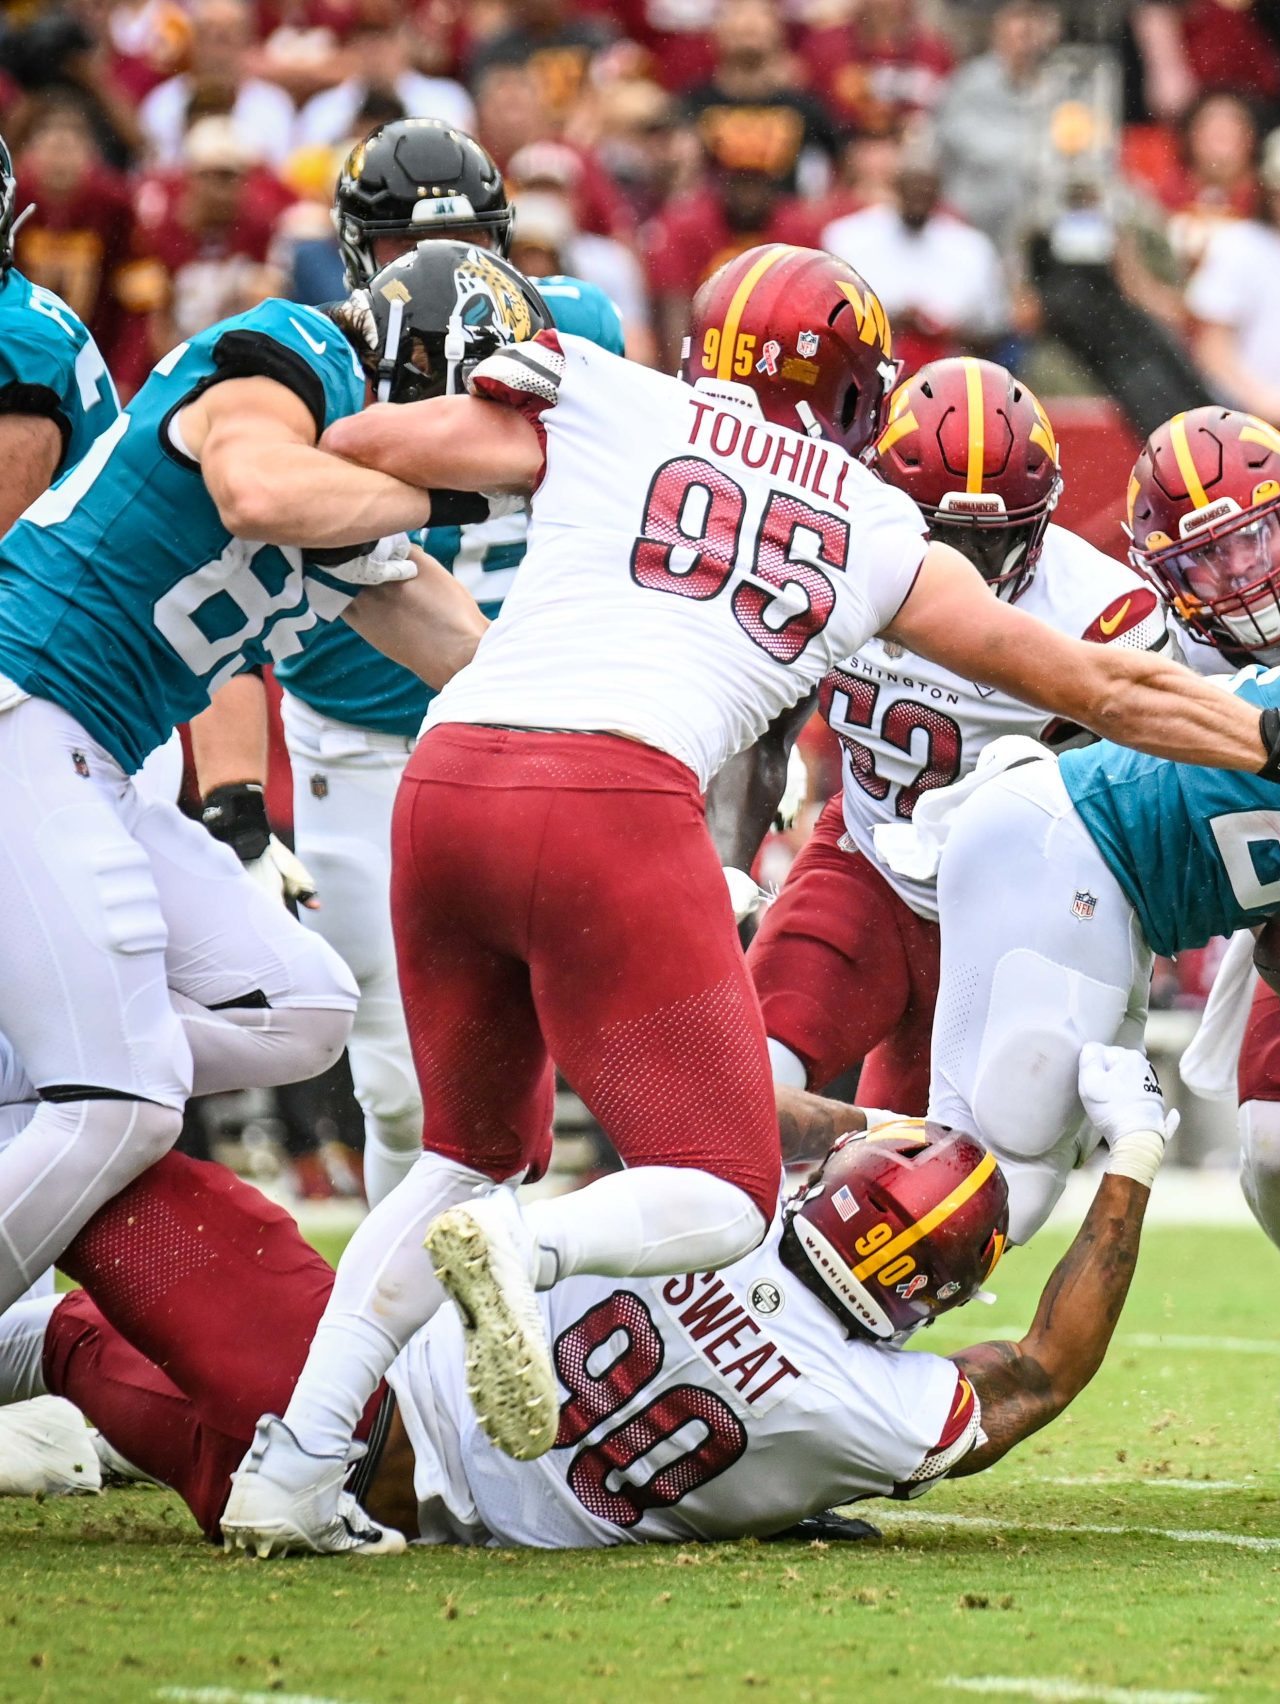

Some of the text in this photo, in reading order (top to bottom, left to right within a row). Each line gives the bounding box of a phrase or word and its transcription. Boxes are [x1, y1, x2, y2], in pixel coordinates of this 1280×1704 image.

[698, 390, 753, 409] SHINGTON
[701, 327, 757, 377] 95
[687, 399, 850, 512] TOOHILL
[629, 454, 852, 666] 95
[848, 656, 959, 705] SHINGTON
[816, 665, 963, 821] 52
[804, 1236, 878, 1327] WASHINGTON
[854, 1222, 917, 1287] 90
[662, 1272, 802, 1405] SWEAT
[553, 1288, 749, 1529] 90
